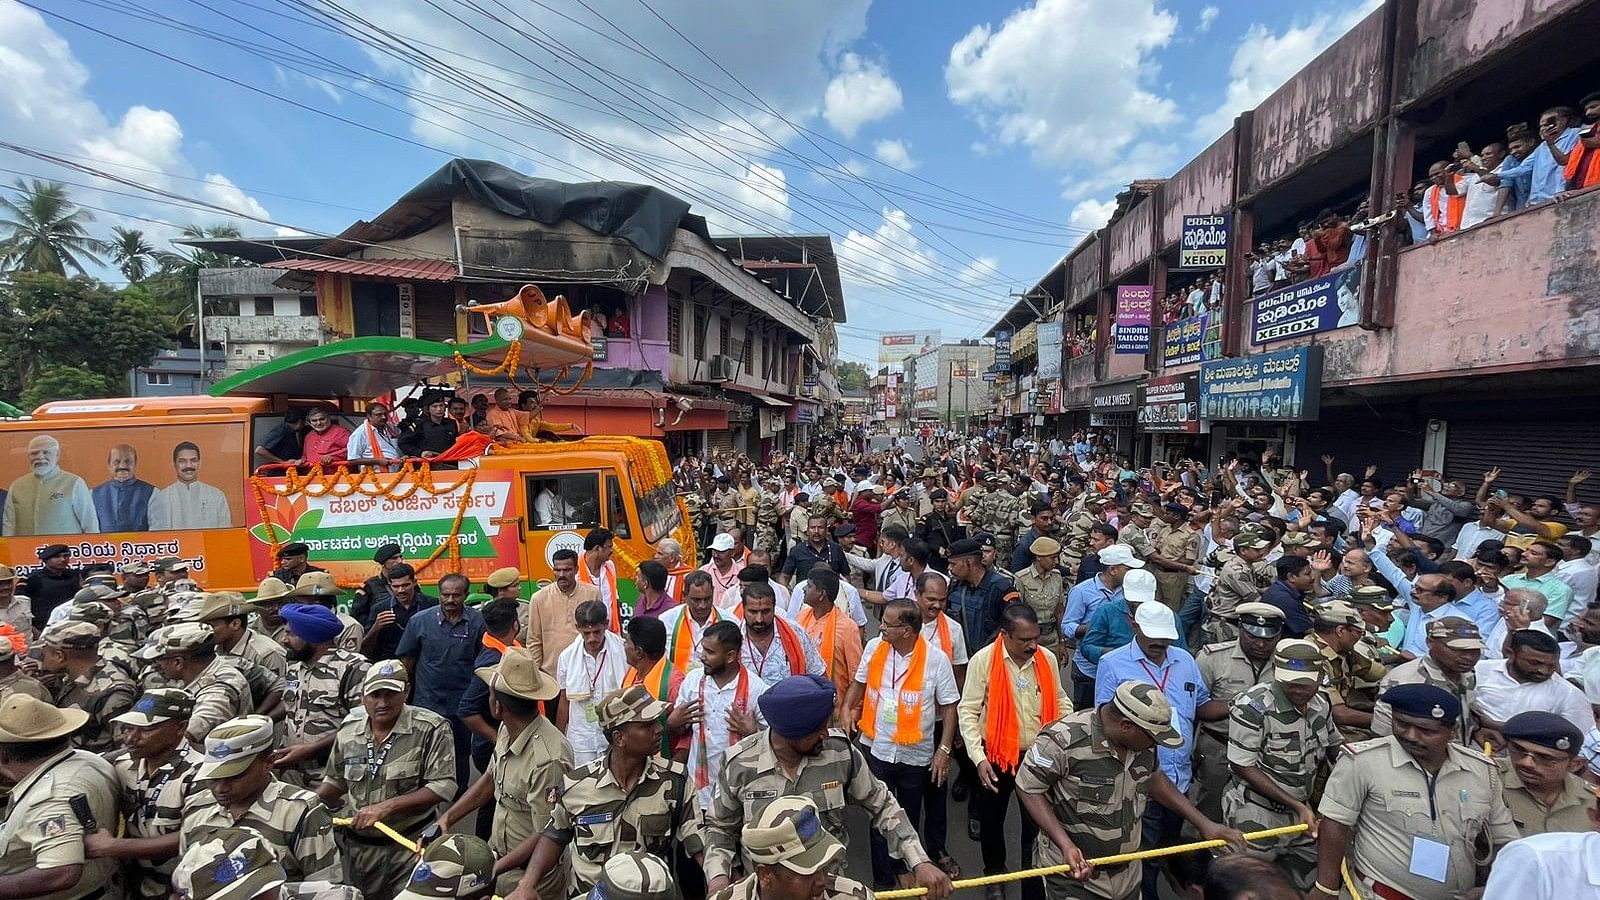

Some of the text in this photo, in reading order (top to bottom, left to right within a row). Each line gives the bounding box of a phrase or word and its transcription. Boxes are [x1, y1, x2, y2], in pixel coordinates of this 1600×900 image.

[1186, 216, 1224, 226] ಉಮಾ
[1184, 226, 1226, 249] ಸ್ಟುಡಿಯೋ
[1184, 255, 1223, 265] XEROX
[1258, 318, 1316, 340] XEROX
[1181, 353, 1201, 364] TAILORS
[1145, 385, 1159, 395] SUPER
[1158, 382, 1185, 394] FOOTWEAR
[1094, 393, 1131, 407] OMKAR SWEETS
[329, 495, 377, 514] ಡಬಲ್
